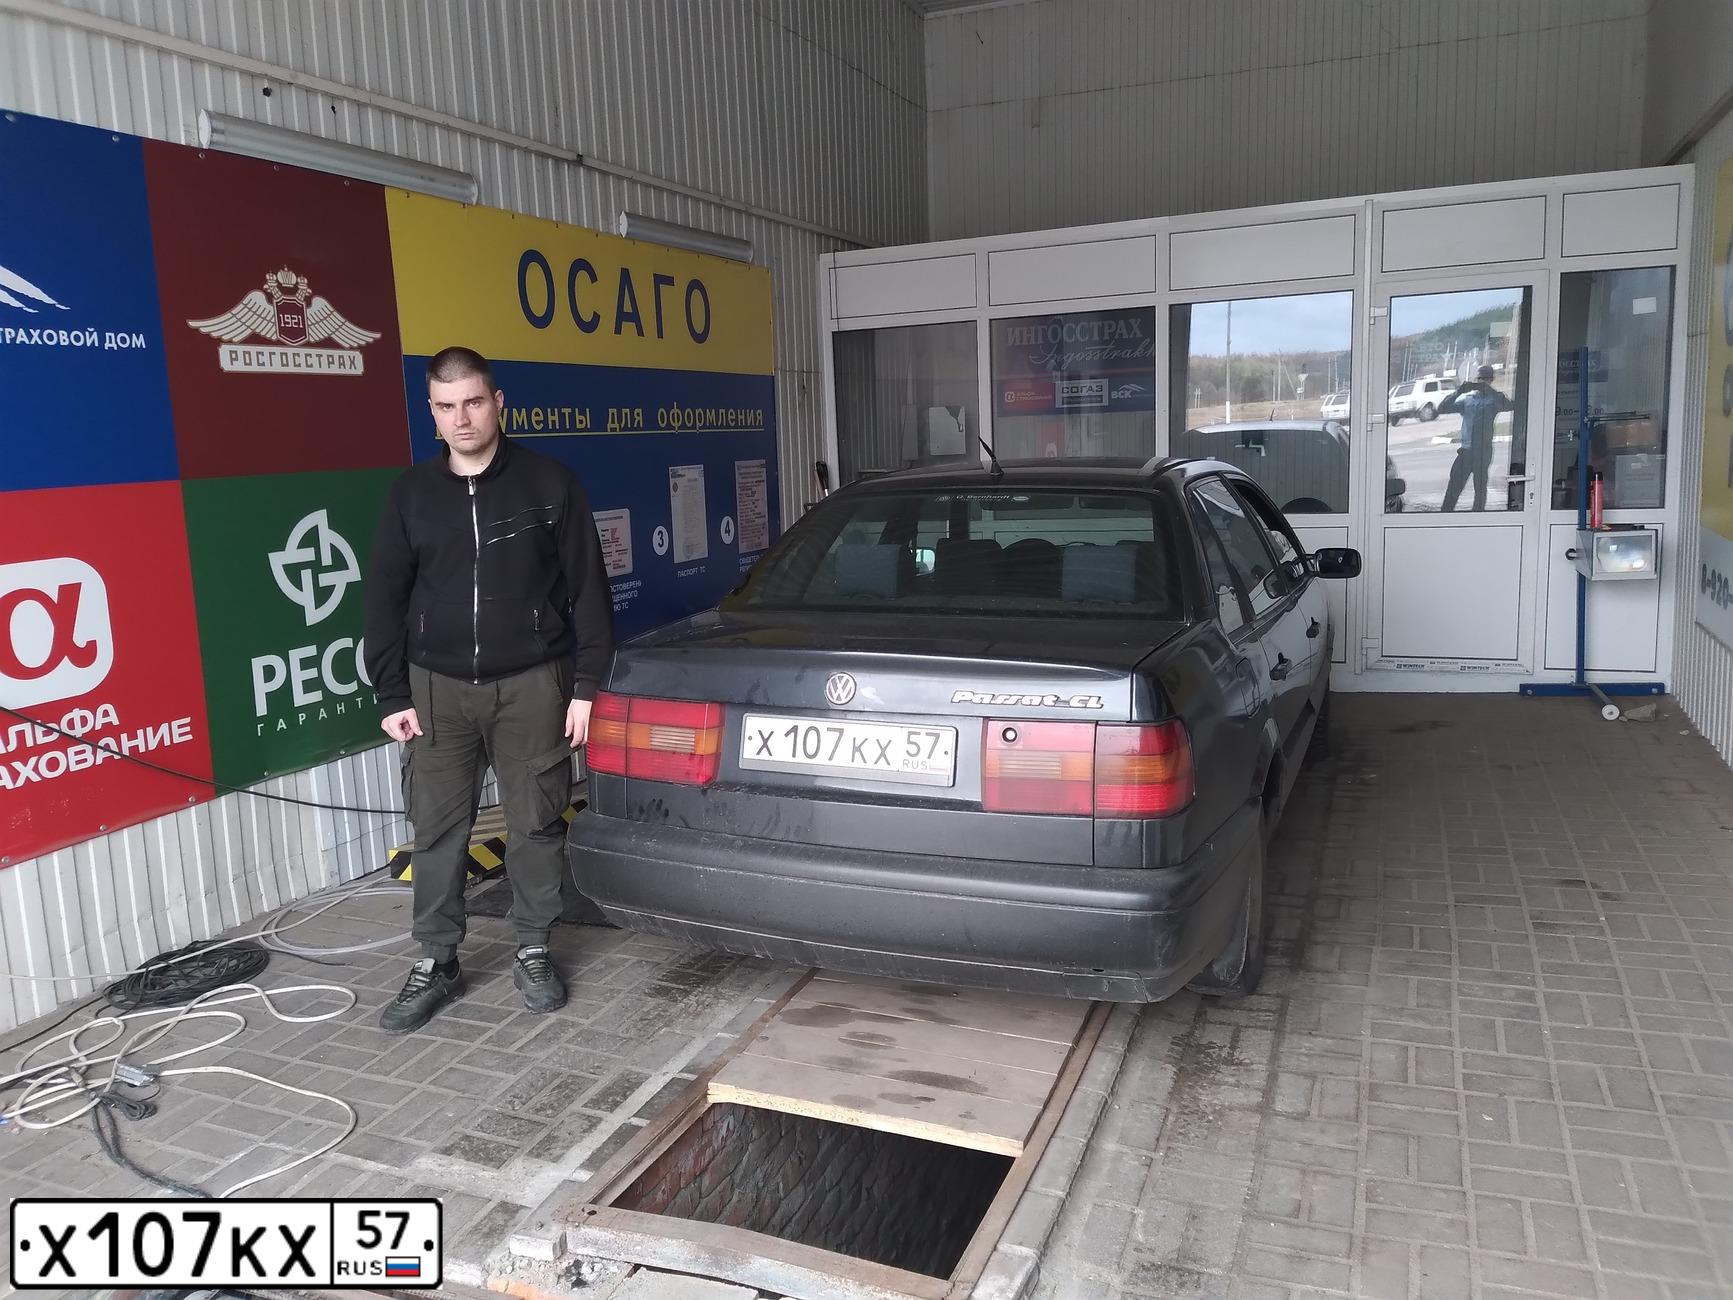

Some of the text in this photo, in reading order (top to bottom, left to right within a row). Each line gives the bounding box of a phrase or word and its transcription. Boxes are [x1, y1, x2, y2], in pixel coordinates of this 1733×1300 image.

[518, 249, 711, 344] ОСАГО
[279, 314, 303, 328] 1921
[1006, 318, 1143, 347] ИНГОССТРАХ
[104, 332, 146, 350] ДОМ
[229, 350, 358, 370] РОСГОССТРАХ
[1062, 384, 1104, 394] СОГАЗ
[1111, 389, 1133, 399] ВСК
[499, 402, 763, 433] ументы для оформления
[657, 530, 664, 544] 3
[724, 522, 731, 537] 4
[905, 730, 941, 760] 57
[902, 759, 928, 771] RUS
